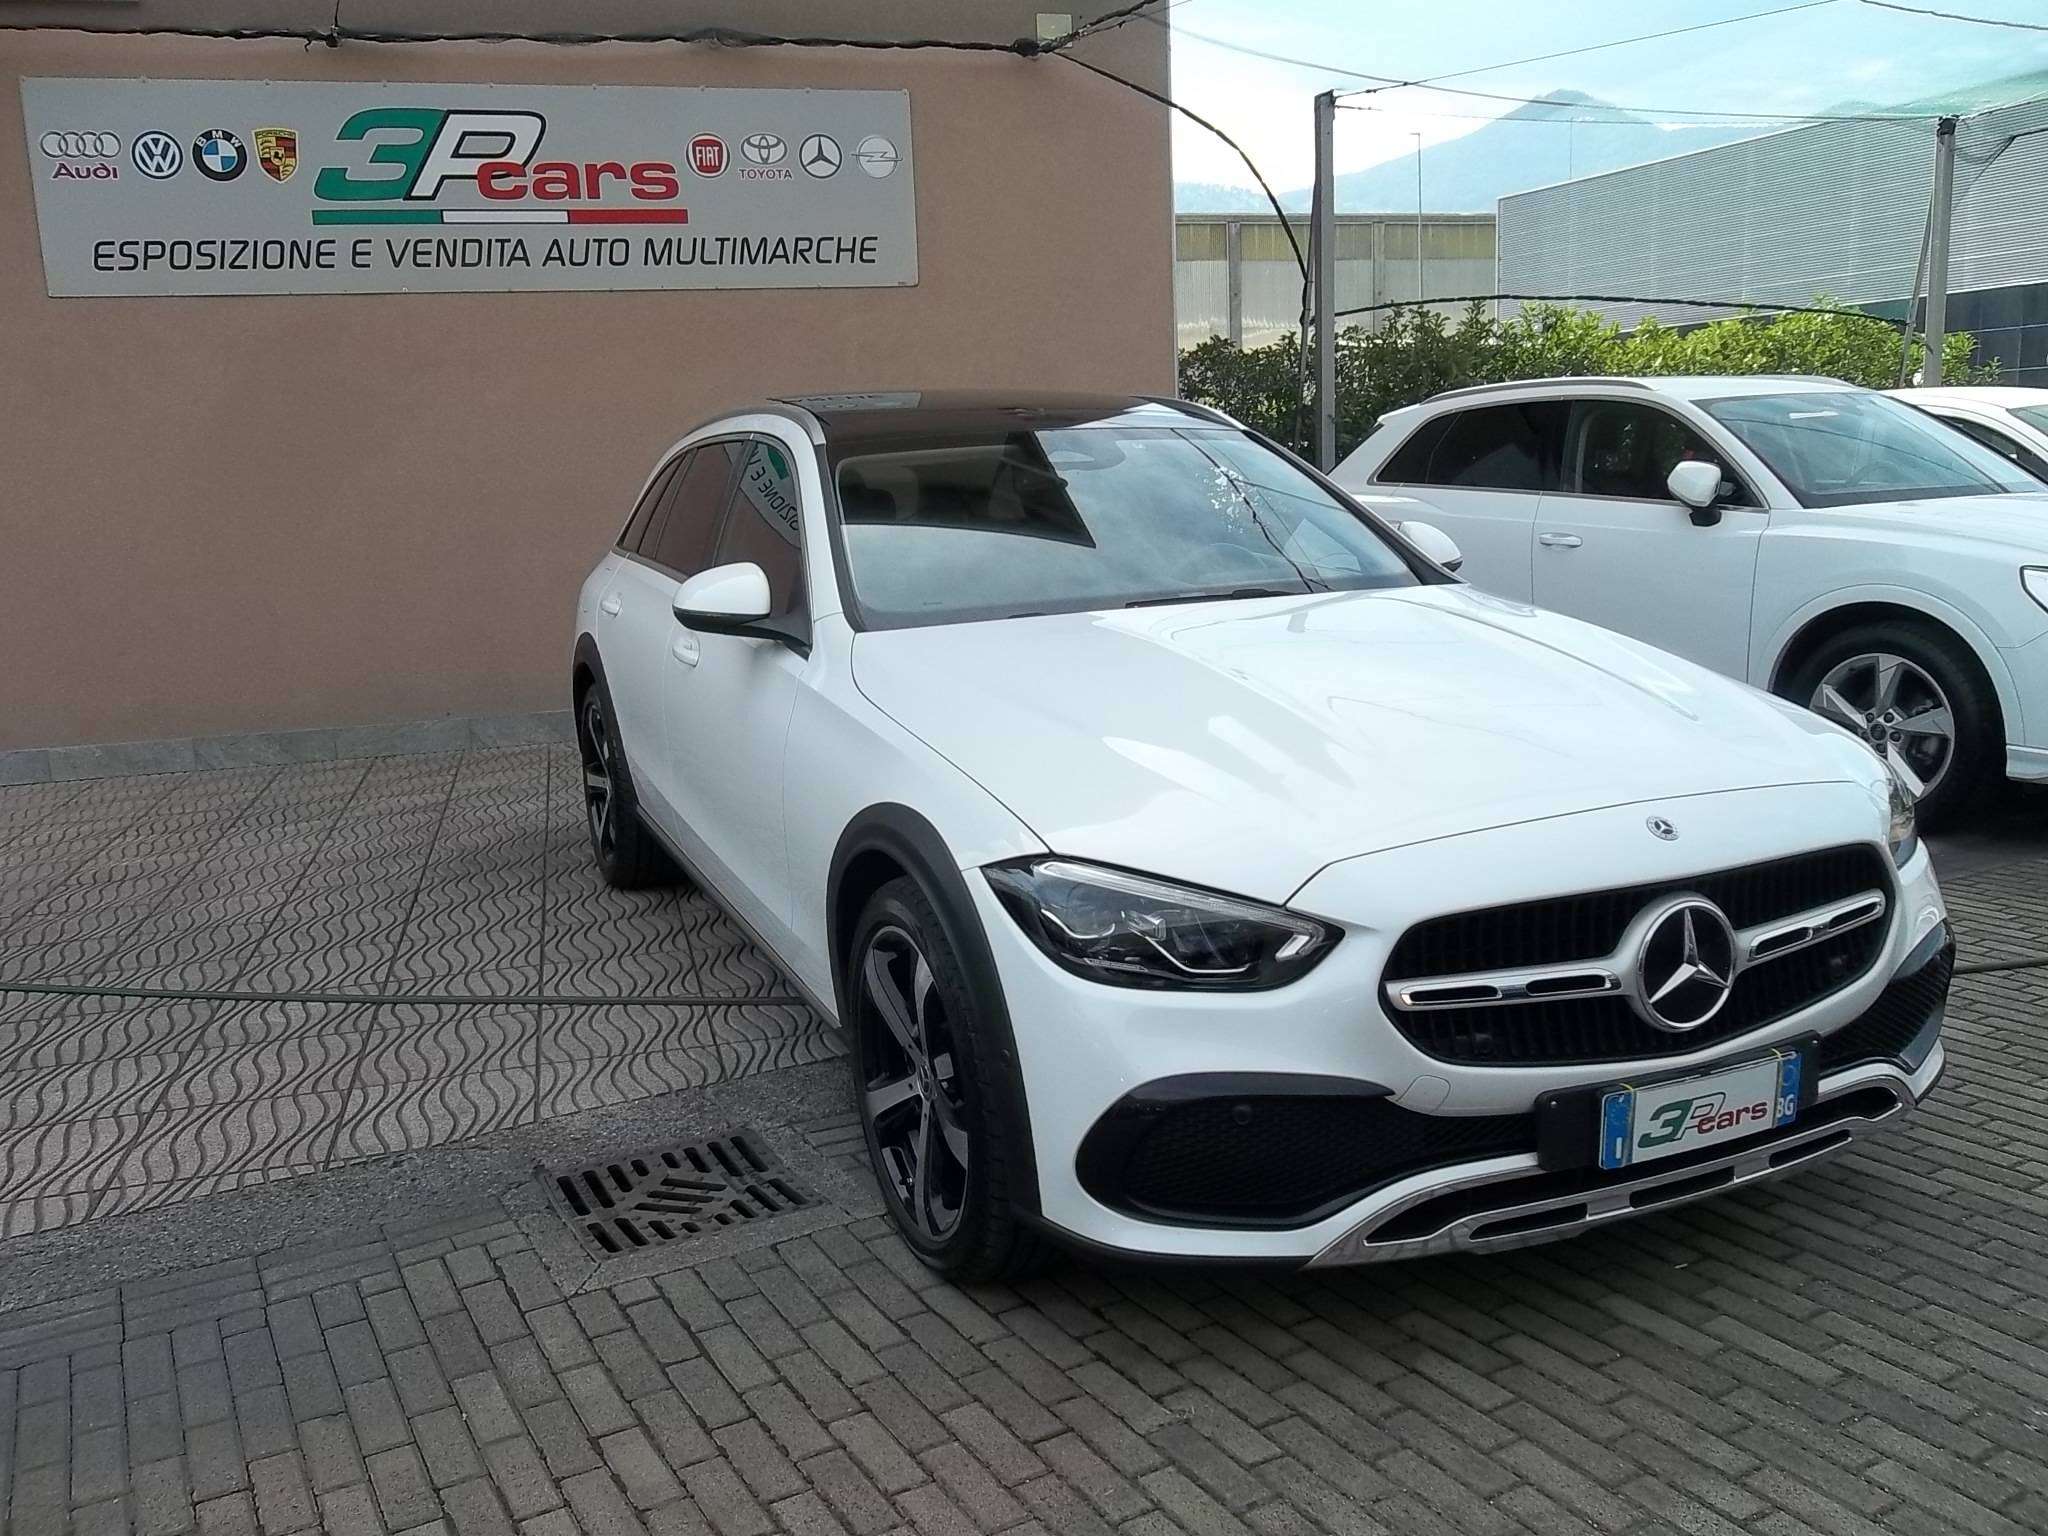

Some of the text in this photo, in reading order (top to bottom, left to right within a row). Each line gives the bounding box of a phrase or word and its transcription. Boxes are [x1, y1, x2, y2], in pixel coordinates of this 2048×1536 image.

[195, 130, 242, 147] BMW
[695, 146, 721, 167] FIAT
[52, 162, 119, 179] Audi
[739, 168, 793, 181] TOYOTA
[93, 236, 879, 271] ESPOSIZIONE E VENDITA AUTO MULTIMARCHE
